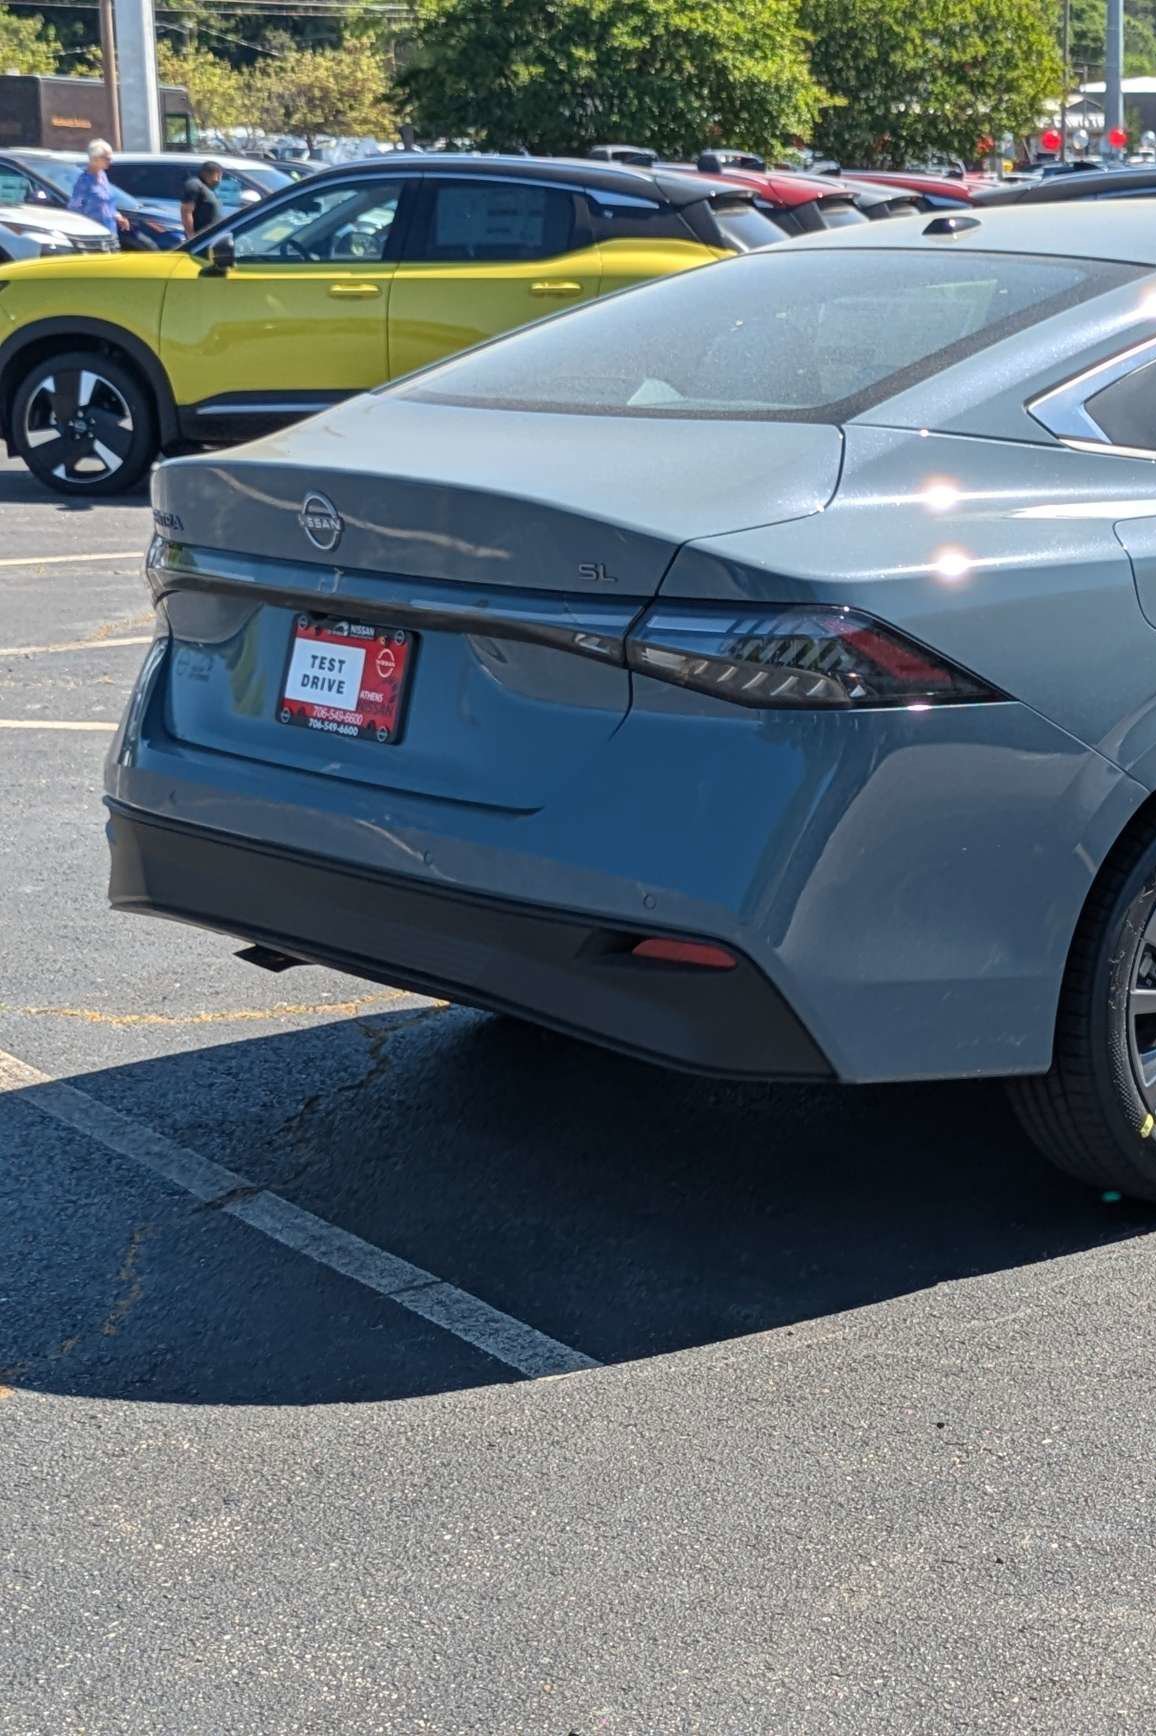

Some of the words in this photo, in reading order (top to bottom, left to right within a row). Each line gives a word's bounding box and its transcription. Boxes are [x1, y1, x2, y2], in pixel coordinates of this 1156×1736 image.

[298, 513, 344, 531] NISSAN
[577, 563, 617, 582] SL
[350, 624, 375, 636] NISSAN
[311, 655, 346, 674] TEST
[301, 674, 346, 695] DRIVE
[360, 690, 384, 703] ATHENS
[308, 718, 359, 736] 706-549-6600
